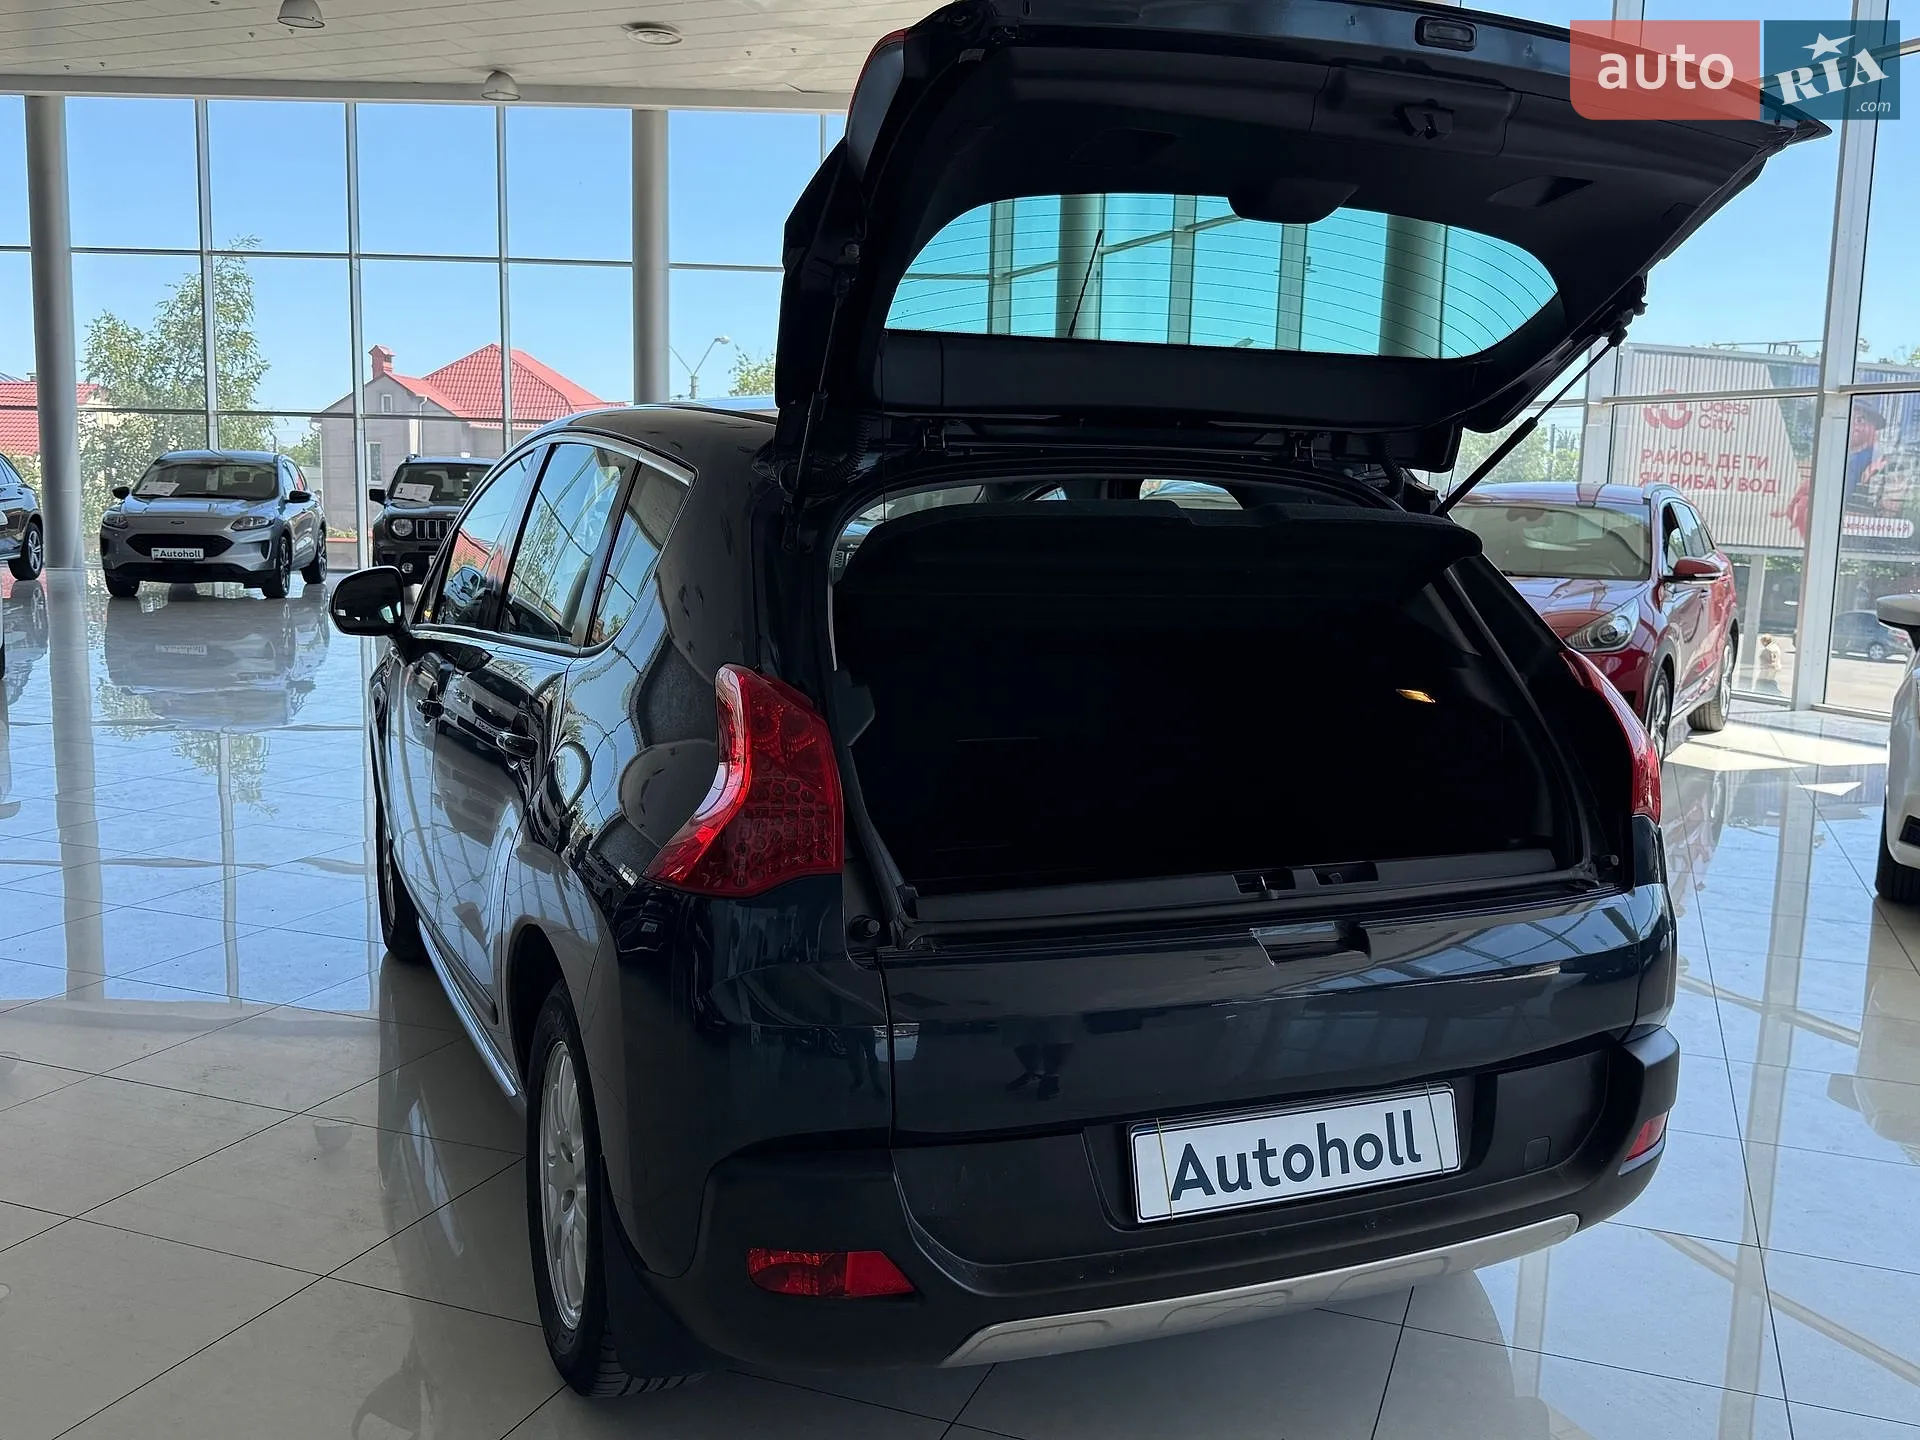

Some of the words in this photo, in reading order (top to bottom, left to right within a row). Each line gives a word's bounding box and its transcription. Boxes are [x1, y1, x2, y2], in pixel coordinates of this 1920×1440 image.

[1640, 444, 1711, 470] РАЙОН,
[1717, 453, 1741, 472] ДЕ
[1746, 455, 1769, 471] ТИ
[159, 549, 201, 558] Autoholl
[1171, 1109, 1422, 1202] Autoholl
